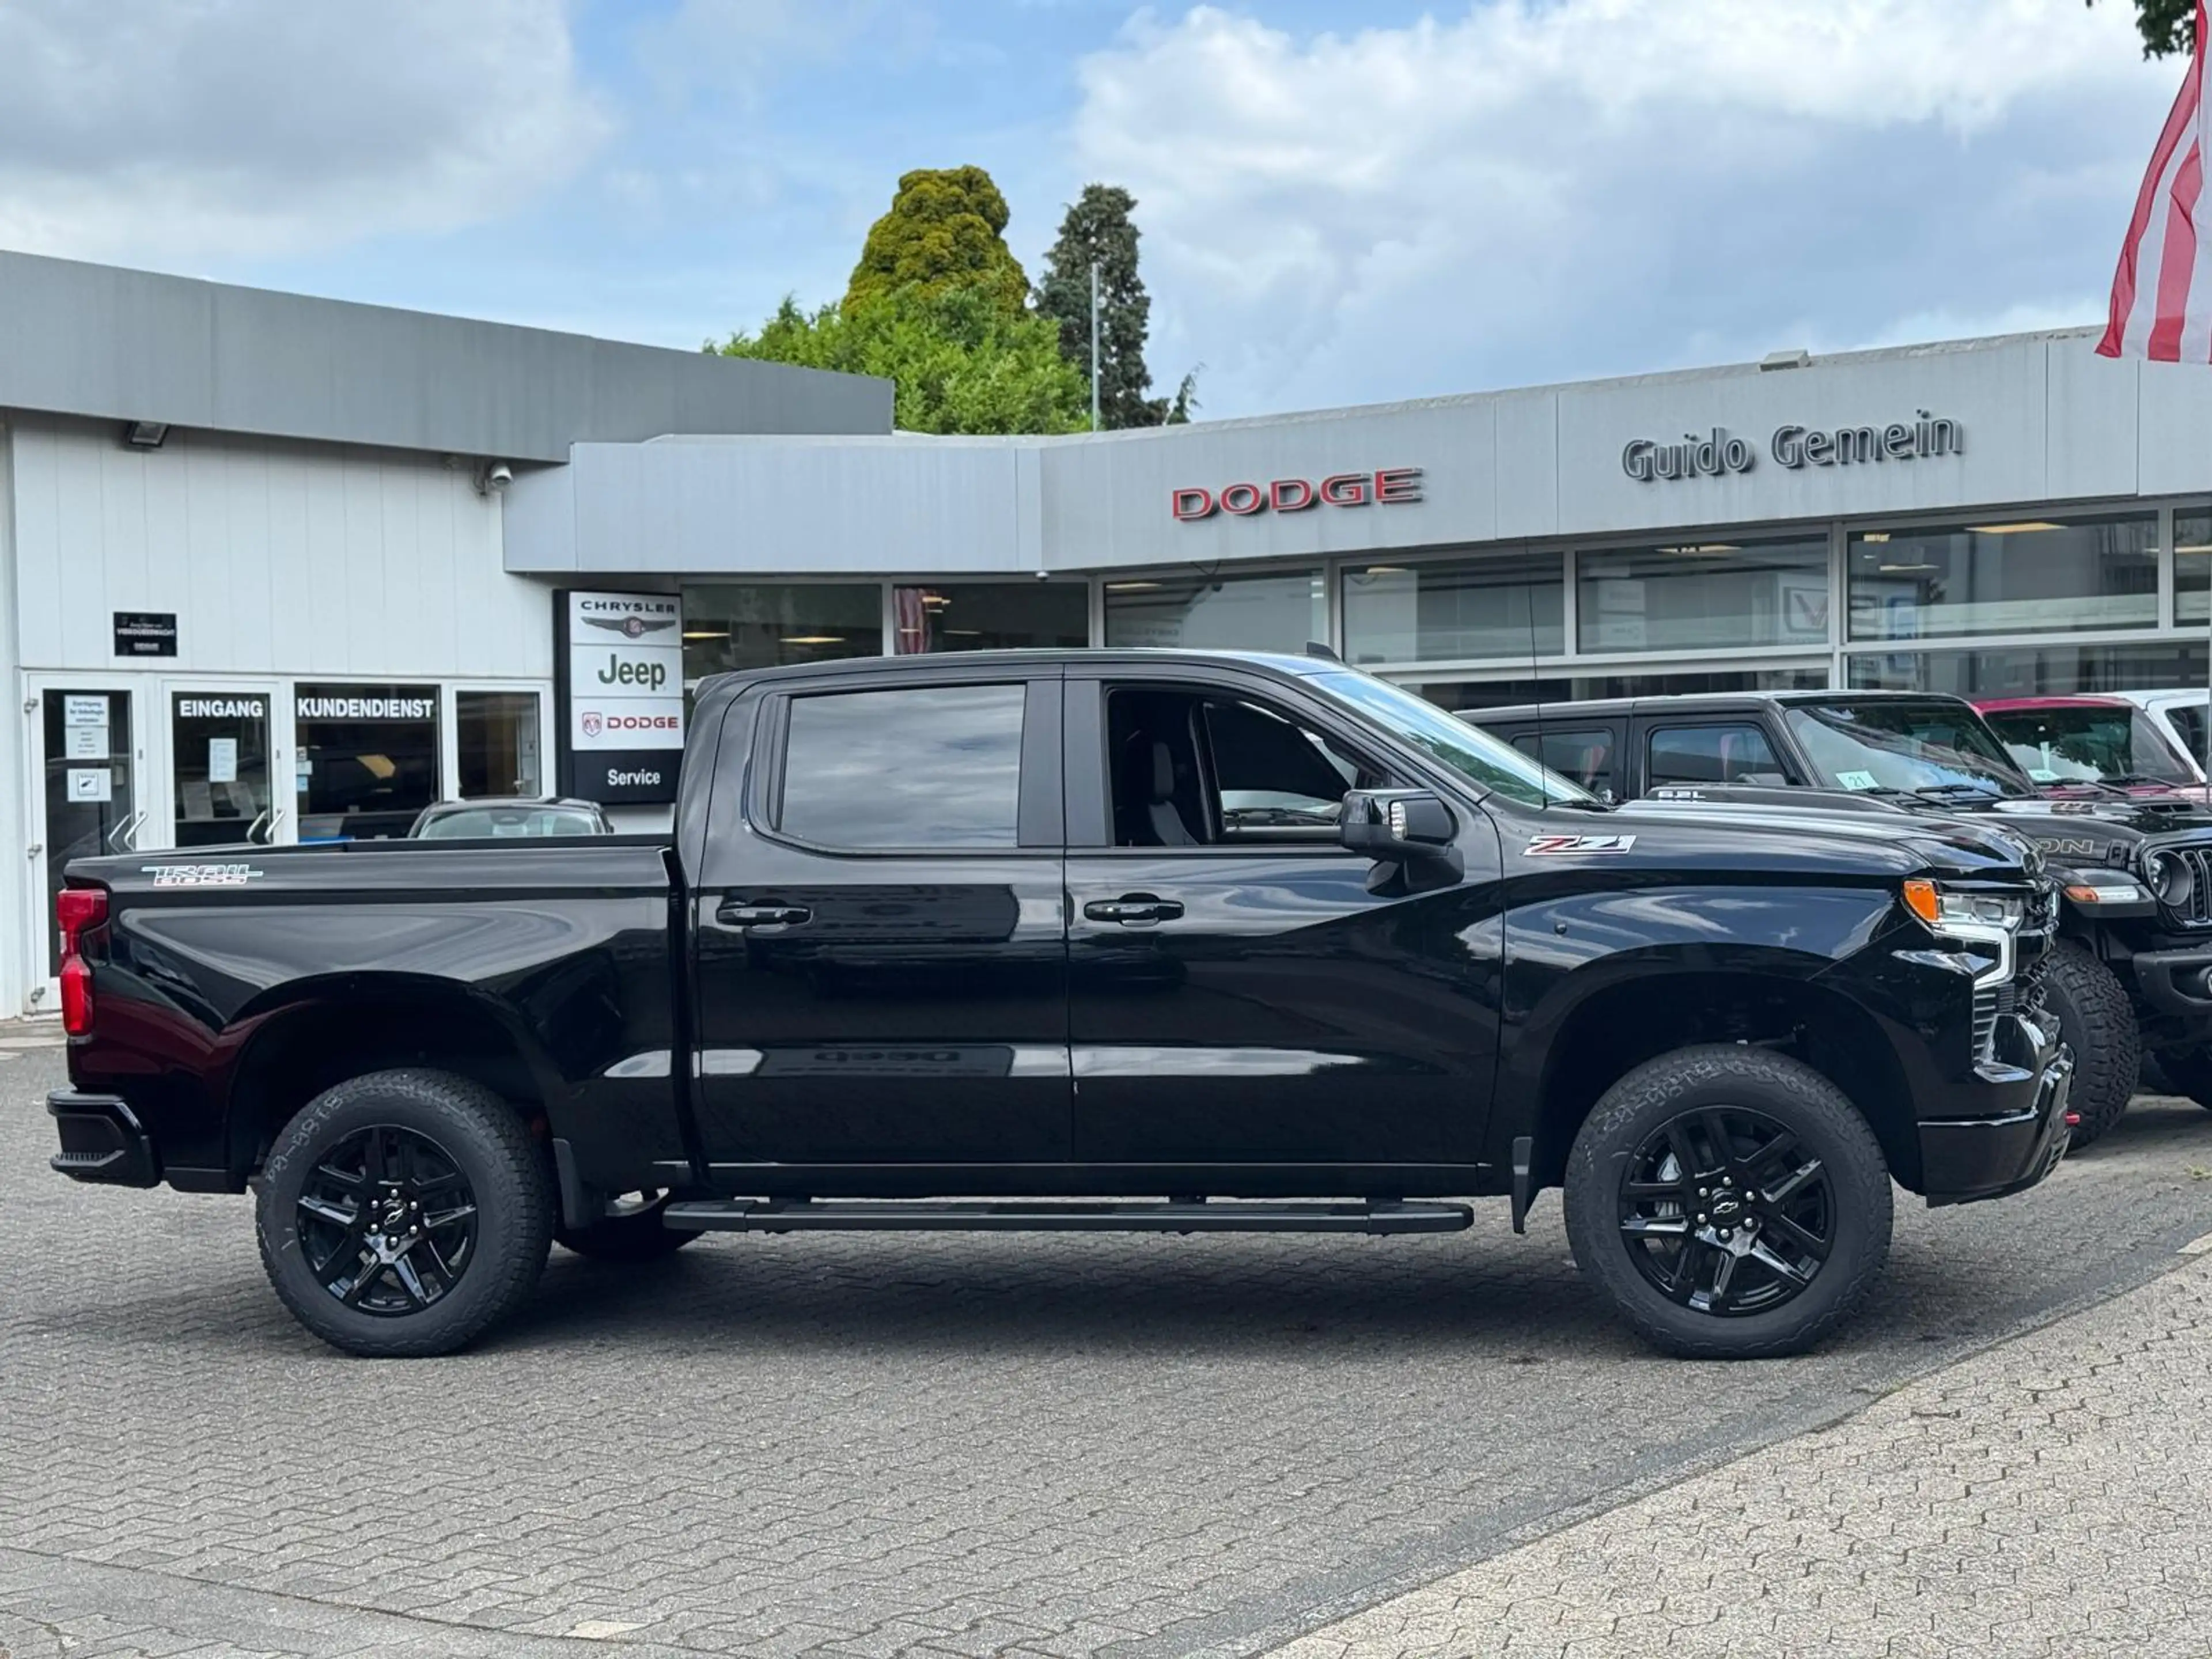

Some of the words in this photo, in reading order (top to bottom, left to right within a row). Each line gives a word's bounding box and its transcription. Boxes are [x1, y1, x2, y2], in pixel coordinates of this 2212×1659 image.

[1622, 427, 1755, 481] Guido
[1771, 408, 1966, 469] Gemein
[1172, 466, 1425, 522] DODGE
[581, 601, 676, 613] CHRYSLER
[597, 653, 666, 691] Jeep
[179, 700, 264, 717] EINGANG
[297, 698, 434, 718] KUNDENDIENST
[607, 716, 679, 729] DODGE
[607, 768, 661, 786] Service
[1524, 835, 1637, 856] Z71
[141, 864, 264, 877] TRAIL
[153, 876, 248, 887] BOSS
